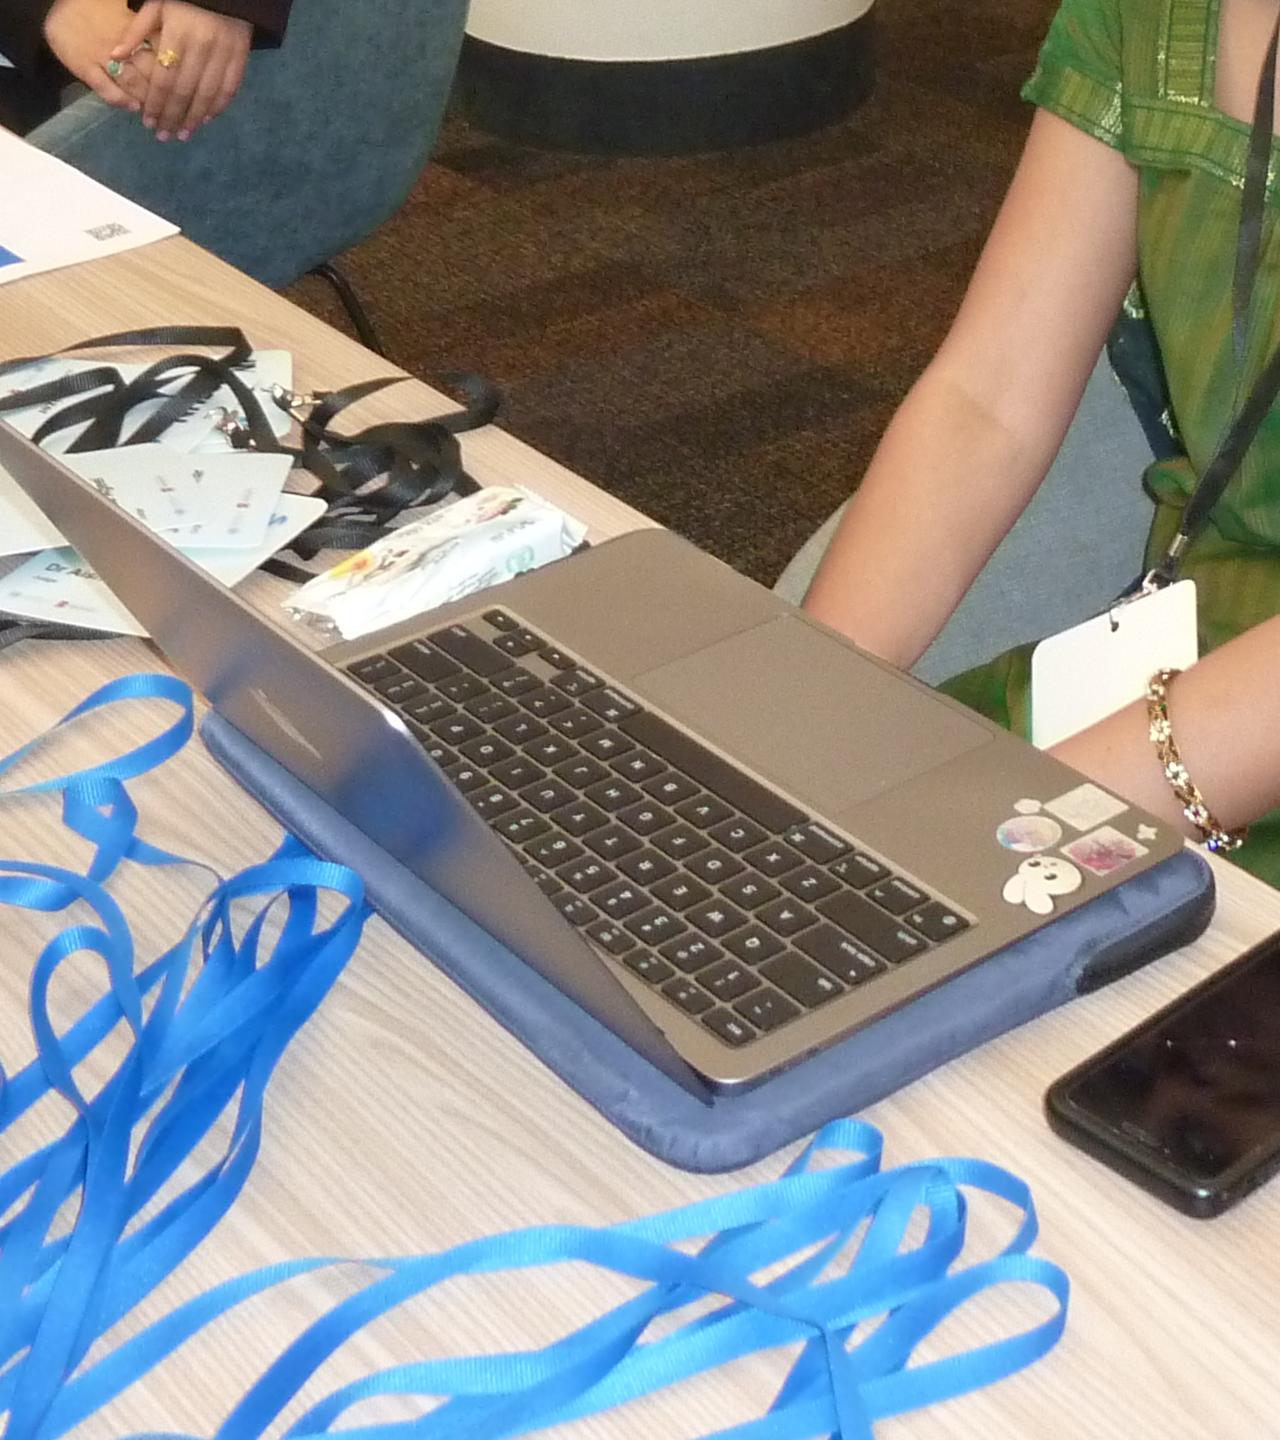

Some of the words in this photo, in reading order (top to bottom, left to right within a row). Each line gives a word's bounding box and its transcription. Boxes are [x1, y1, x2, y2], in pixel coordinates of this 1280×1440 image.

[45, 563, 68, 572] Dr
[450, 724, 464, 733] P
[515, 722, 528, 732] L
[598, 738, 614, 749] M
[479, 744, 494, 754] O
[543, 744, 558, 754] K
[630, 760, 646, 770] N
[458, 771, 473, 780] 9
[574, 766, 588, 775] J
[663, 782, 678, 792] B
[540, 789, 555, 799] U
[605, 788, 620, 797] H
[489, 793, 503, 803] 8
[696, 805, 710, 815] V
[572, 813, 586, 821] Y
[638, 812, 654, 821] G
[520, 818, 534, 826] 7
[731, 828, 745, 839] C
[552, 839, 567, 850] 6
[604, 837, 619, 846] T
[672, 837, 687, 846] F
[766, 852, 781, 862] X
[638, 860, 654, 871] R
[707, 860, 722, 870] D
[801, 877, 817, 887] Z
[673, 885, 688, 895] E
[742, 884, 757, 895] S
[706, 910, 724, 923] W
[780, 910, 794, 920] A
[745, 937, 760, 948] Q
